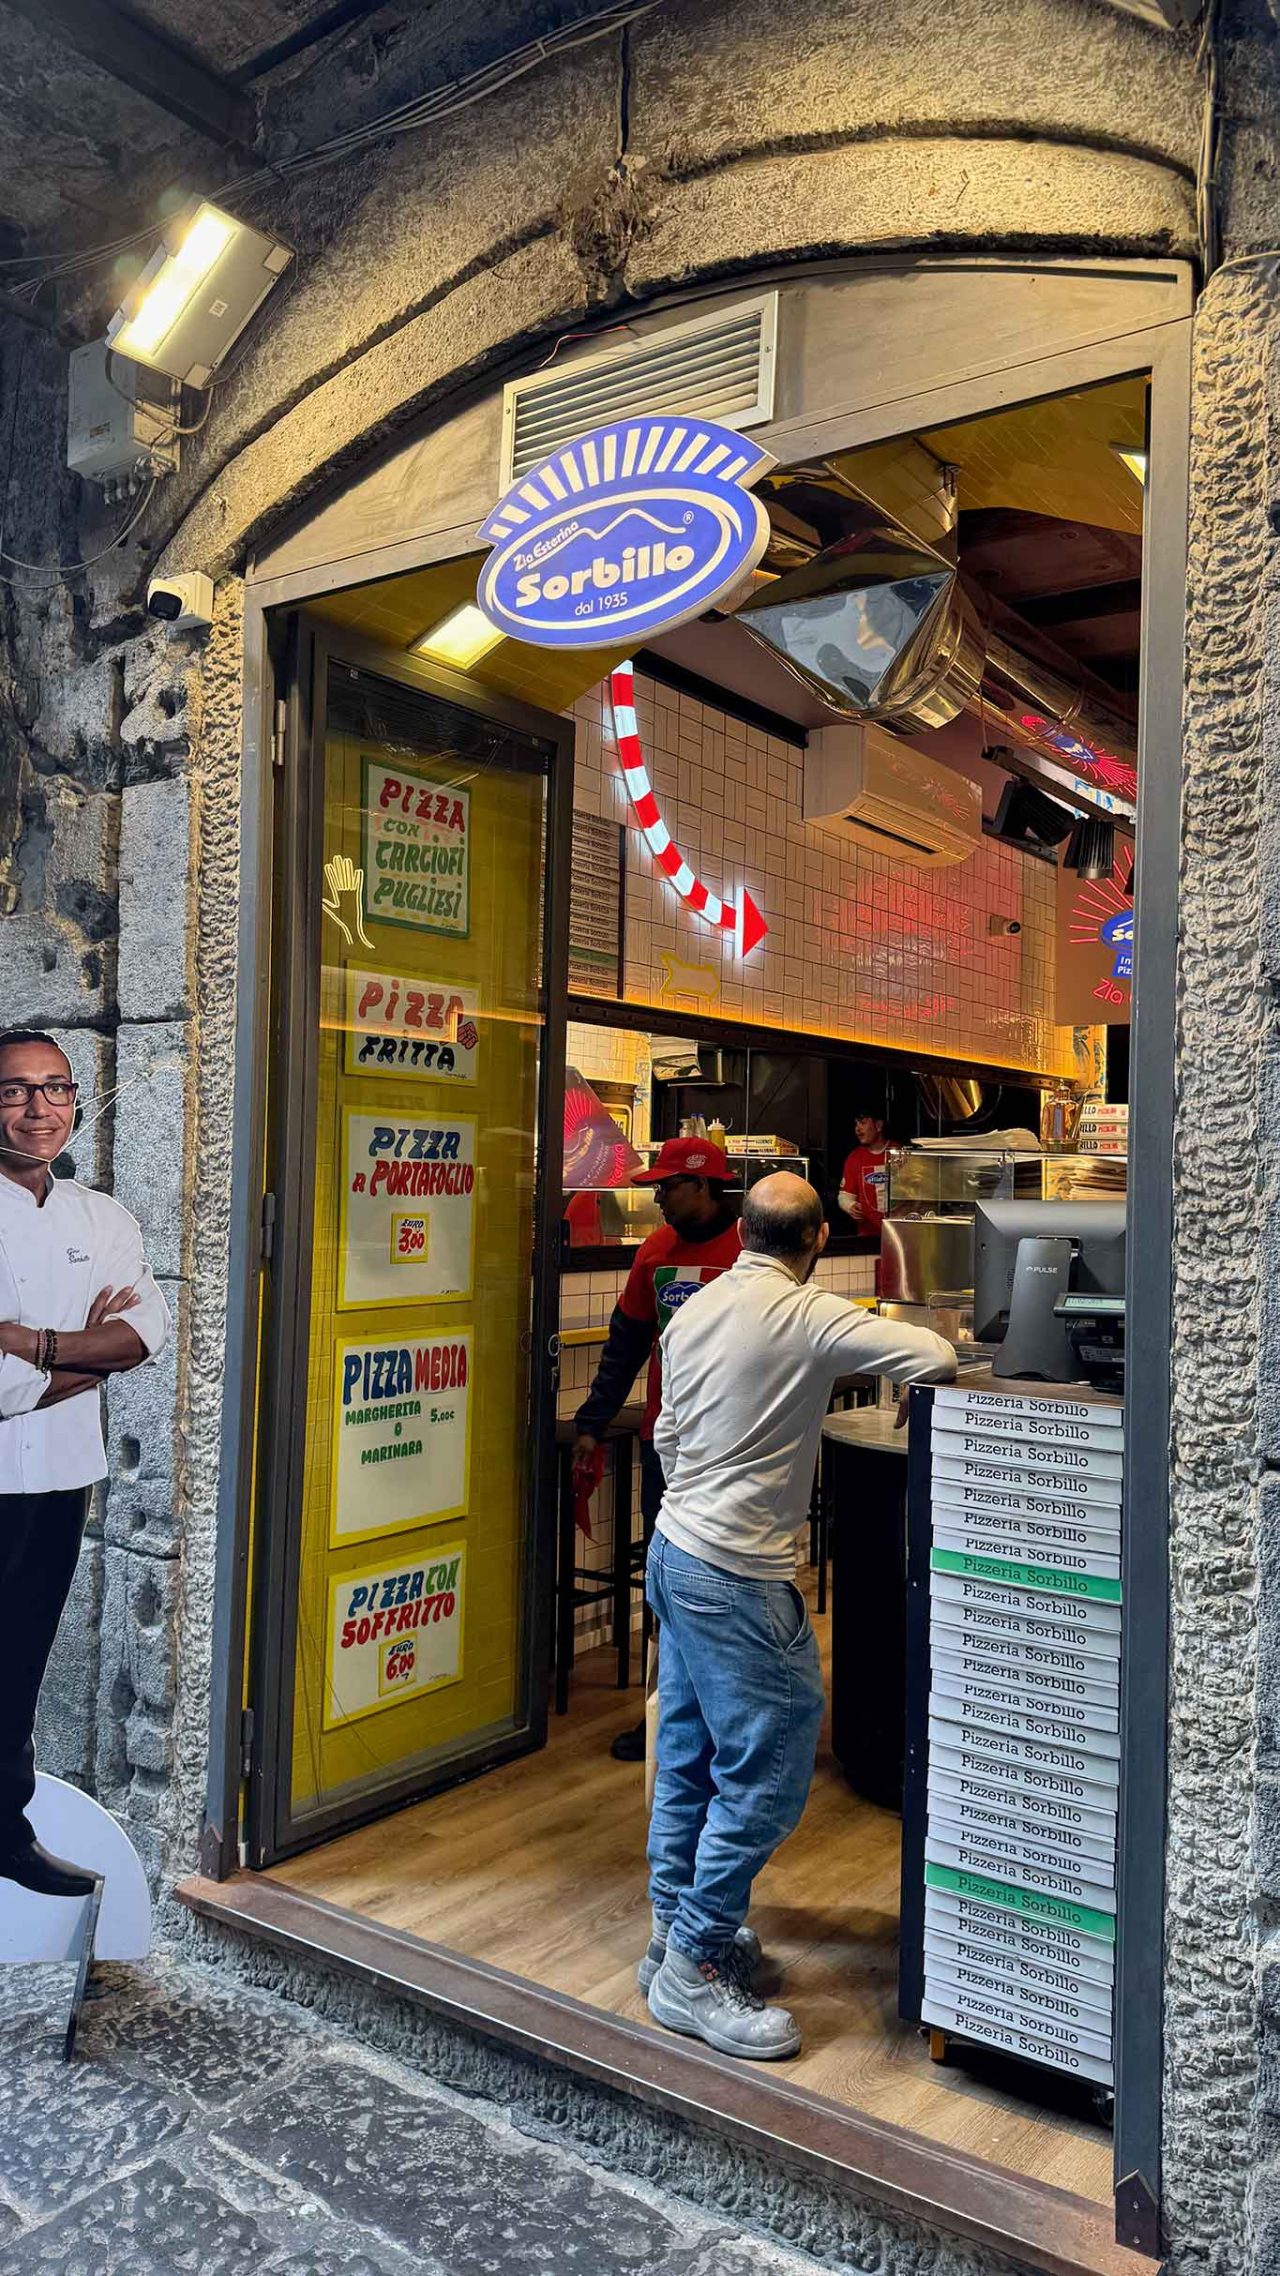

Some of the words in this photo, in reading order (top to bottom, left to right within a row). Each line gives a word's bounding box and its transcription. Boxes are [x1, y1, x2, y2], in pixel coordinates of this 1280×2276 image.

[513, 554, 533, 571] Zia
[533, 521, 579, 558] Esterina
[516, 542, 695, 608] Sorbillo
[574, 599, 593, 616] dal
[598, 592, 628, 611] 1935
[379, 778, 465, 833] PIZZA
[383, 818, 420, 837] CON
[1093, 977, 1124, 1006] Zia
[368, 1127, 461, 1159] PIZZA
[352, 1172, 367, 1193] A
[370, 1160, 475, 1197] PORTAFOGLIO
[400, 1218, 424, 1229] EURO
[342, 1348, 412, 1406] PIZZA
[415, 1344, 467, 1392] MEDIA
[345, 1400, 421, 1425] MARGHERITA
[968, 1393, 1023, 1410] Pizzeria
[1029, 1400, 1088, 1417] Sorbillo
[394, 1422, 402, 1436] O
[965, 1412, 1023, 1431] Pizzeria
[1029, 1421, 1089, 1440] Sorbillo
[361, 1440, 423, 1465] MARINARA
[964, 1438, 1022, 1458] Pizzeria
[1028, 1447, 1088, 1467] Sorbillo
[964, 1463, 1022, 1483] Pizzeria
[1027, 1473, 1088, 1493] Sorbillo
[964, 1488, 1021, 1508] Pizzeria
[1026, 1498, 1086, 1519] Sorbillo
[964, 1513, 1021, 1532] Pizzeria
[1027, 1522, 1087, 1543] Sorbillo
[965, 1538, 1022, 1557] Pizzeria
[1027, 1549, 1087, 1568] Sorbillo
[348, 1570, 424, 1618] PIZZA
[426, 1557, 461, 1595] CON
[963, 1558, 1020, 1580] Pizzeria
[1027, 1570, 1087, 1592] Sorbillo
[963, 1584, 1020, 1606] Pizzeria
[1026, 1597, 1087, 1619] Sorbillo
[341, 1592, 455, 1648] SOFFRITTO
[963, 1609, 1020, 1631] Pizzeria
[1026, 1622, 1086, 1644] Sorbillo
[962, 1634, 1019, 1657] Pizzeria
[1025, 1647, 1085, 1670] Sorbillo
[963, 1659, 1020, 1680] Pizzeria
[1026, 1672, 1085, 1695] Sorbillo
[964, 1684, 1020, 1706] Pizzeria
[1026, 1699, 1085, 1720] Sorbillo
[962, 1703, 1020, 1728] Pizzeria
[1025, 1719, 1086, 1743] Sorbillo
[961, 1730, 1019, 1755] Pizzeria
[1024, 1746, 1085, 1771] Sorbillo
[961, 1754, 1018, 1780] Pizzeria
[1024, 1772, 1084, 1797] Sorbillo
[960, 1780, 1017, 1806] Pizzeria
[1022, 1797, 1082, 1823] Sorbillo
[960, 1805, 1017, 1829] Pizzeria
[1022, 1822, 1082, 1847] Sorbillo
[961, 1831, 1017, 1855] Pizzeria
[1023, 1849, 1081, 1873] Sorbillo
[959, 1850, 1017, 1877] Pizzeria
[1022, 1868, 1082, 1896] Sorbillo
[958, 1876, 1015, 1904] Pizzeria
[1022, 1895, 1082, 1923] Sorbillo
[958, 1900, 1015, 1928] Pizzeria
[1021, 1919, 1080, 1949] Sorbillo
[958, 1917, 1015, 1946] Pizzeria
[1021, 1939, 1080, 1967] Sorbillo
[957, 1943, 1014, 1972] Pizzeria
[1020, 1962, 1078, 1993] Sorbillo
[957, 1968, 1014, 1996] Pizzeria
[1019, 1988, 1078, 2018] Sorbillo
[957, 1995, 1014, 2022] Pizzeria
[1019, 2014, 1078, 2044] Sorbillo
[955, 2013, 1013, 2045] Pizzeria
[1018, 2036, 1079, 2068] Sorbillo
